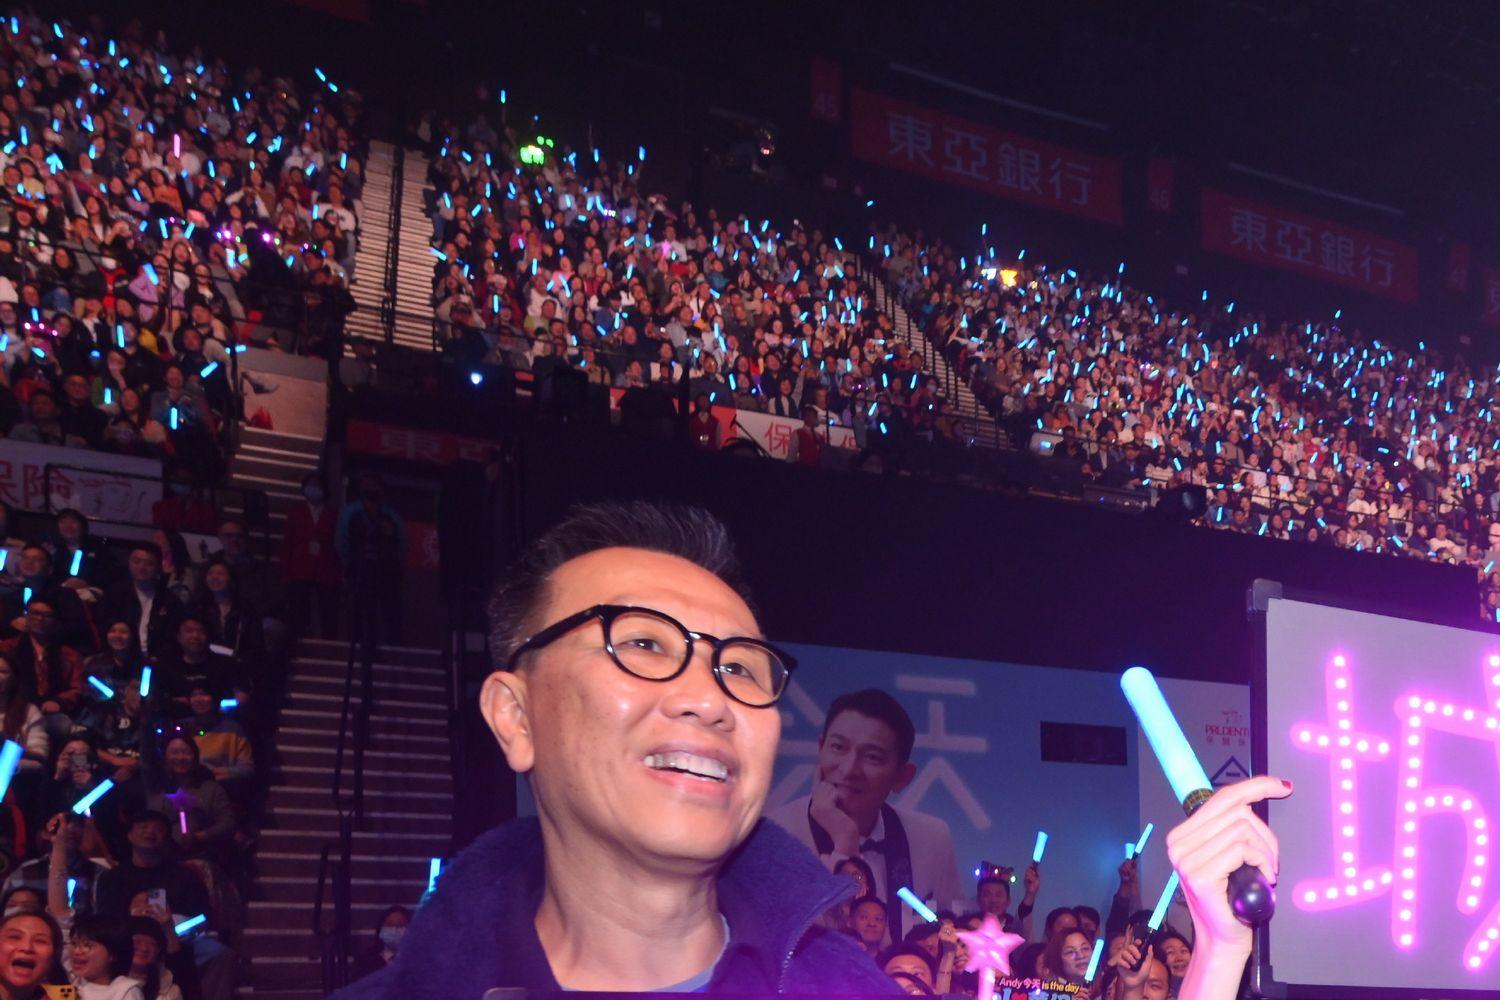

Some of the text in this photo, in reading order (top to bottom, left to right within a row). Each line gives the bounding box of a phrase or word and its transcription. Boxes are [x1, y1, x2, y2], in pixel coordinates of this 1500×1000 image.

[886, 111, 1093, 206] 東亞銀行
[1230, 206, 1396, 287] 東亞銀行
[999, 976, 1022, 989] Andy
[1050, 981, 1065, 992] the
[1065, 982, 1081, 995] day
